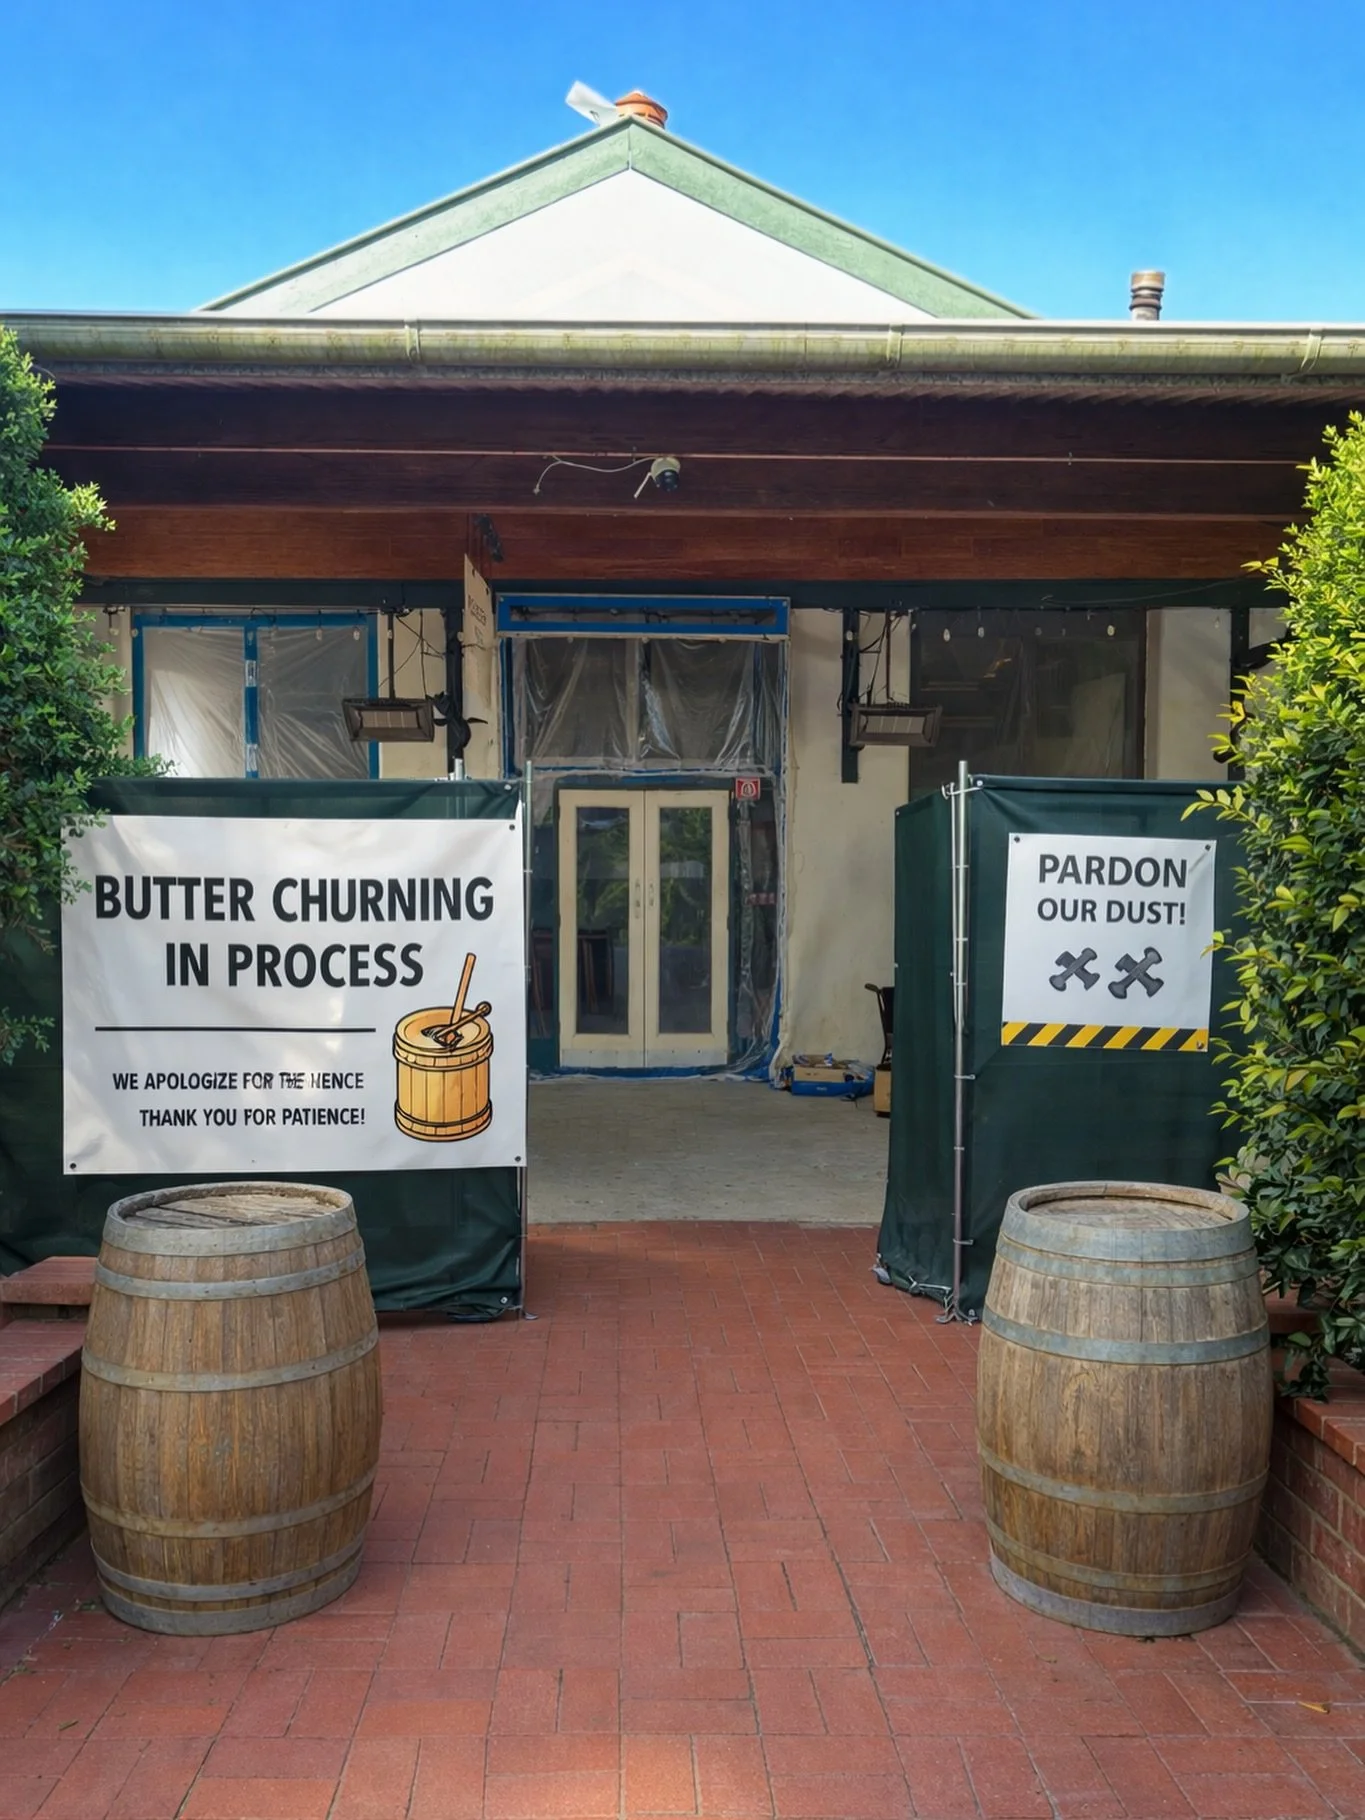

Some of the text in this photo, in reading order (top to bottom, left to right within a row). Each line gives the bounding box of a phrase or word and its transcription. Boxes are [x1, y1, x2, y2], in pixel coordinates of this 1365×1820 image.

[1039, 854, 1187, 888] PARDON
[95, 875, 494, 922] BUTTER CHURNING
[1037, 898, 1186, 925] OUR DUST!
[166, 942, 424, 988] IN PROCESS
[112, 1073, 139, 1090] WE
[144, 1072, 238, 1090] APOLOGIZE
[243, 1072, 274, 1090] FOR
[139, 1107, 365, 1127] THANK YOU FOR PATIENCE!
